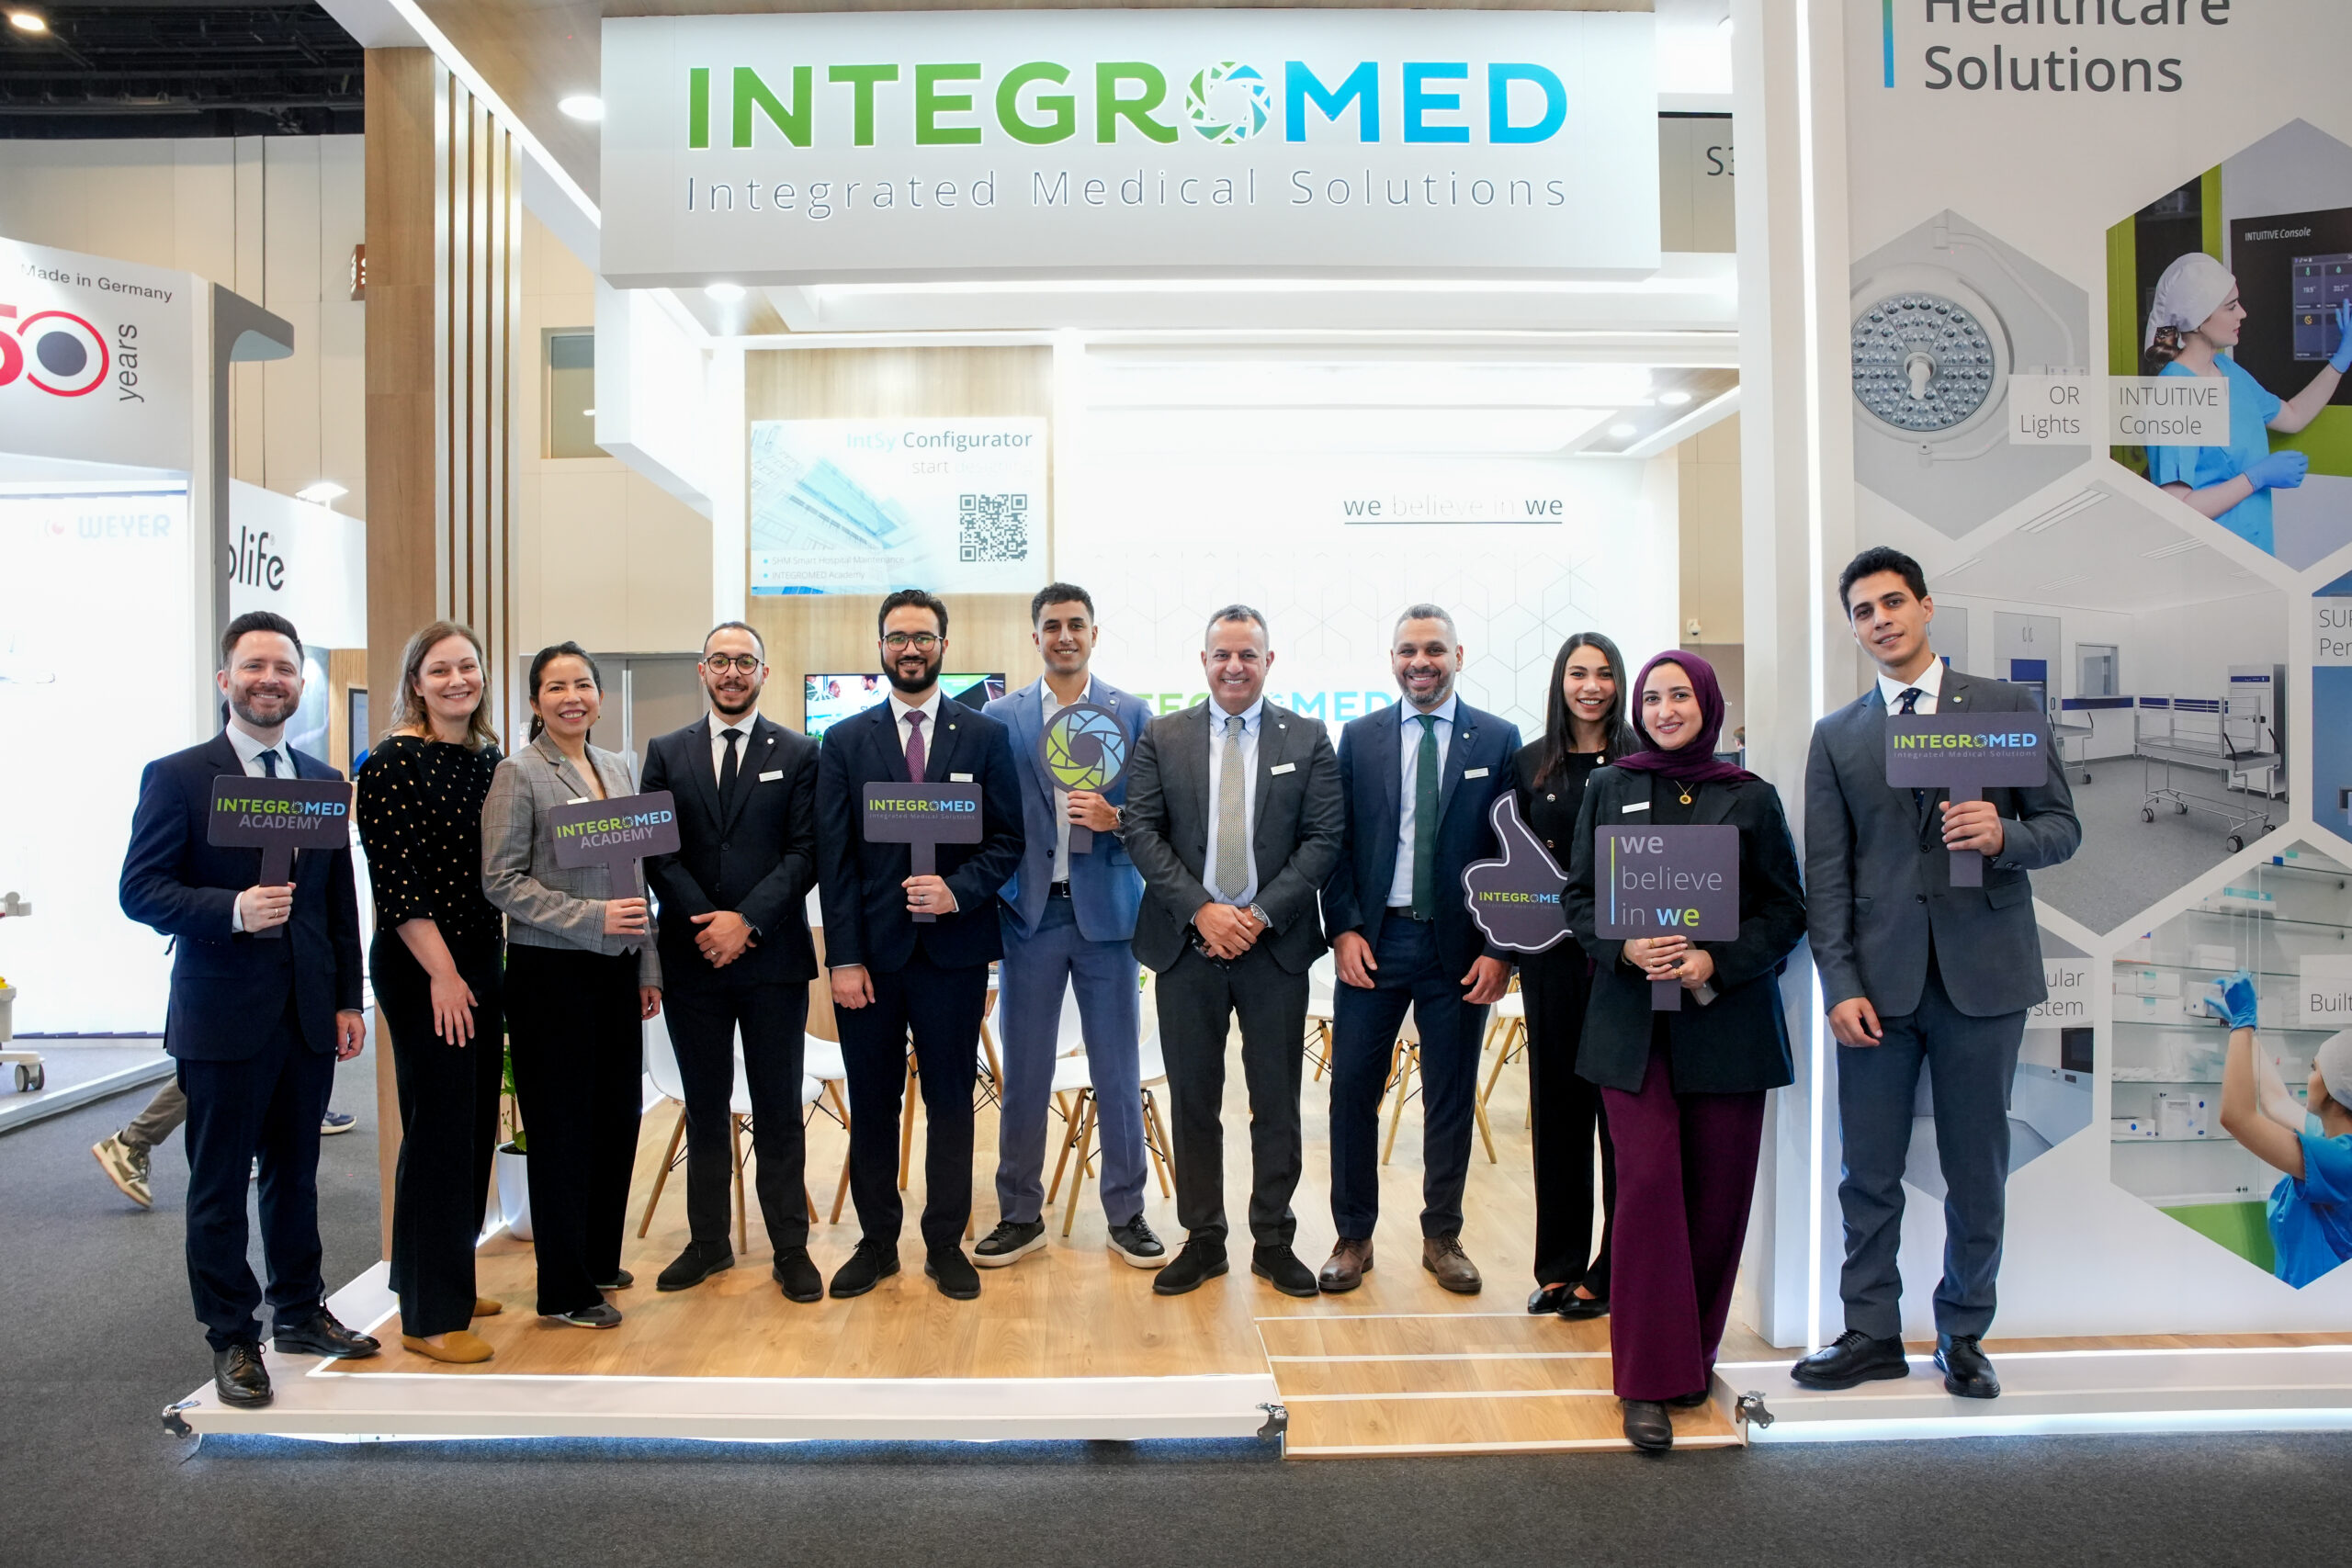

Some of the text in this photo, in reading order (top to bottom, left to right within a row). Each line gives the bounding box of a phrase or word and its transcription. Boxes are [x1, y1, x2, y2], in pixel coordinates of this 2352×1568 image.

[1925, 44, 2183, 92] Solutions
[688, 61, 1569, 150] INTEGROMED
[1706, 146, 1735, 176] S
[686, 168, 1568, 220] Integrated Medical Solutions
[2245, 227, 2312, 242] INTUITIVE Console
[21, 264, 173, 303] Made in Germany
[119, 324, 144, 402] years
[2049, 386, 2080, 405] OR
[2120, 387, 2219, 406] INTUITIVE
[2020, 414, 2080, 438] Lights
[2120, 415, 2202, 434] Console
[903, 431, 1033, 452] Configurator
[911, 460, 949, 474] start
[1343, 500, 1381, 516] we
[1393, 492, 1483, 516] believe
[1525, 499, 1563, 515] we
[77, 514, 172, 539] WEYER
[1894, 733, 2037, 749] INTEGROMED
[1894, 750, 1945, 760] Integrated
[1989, 750, 2037, 758] Solutions
[216, 797, 346, 817] INTEGROMED
[869, 799, 976, 812] INTEGROMED
[239, 814, 322, 830] ACADEMY
[557, 810, 673, 838] INTEGROMED
[580, 827, 654, 850] ACADEMY
[1621, 836, 1664, 854] we
[1622, 865, 1723, 891] believe
[1479, 891, 1561, 904] INTEGROME
[1622, 902, 1700, 928] in we
